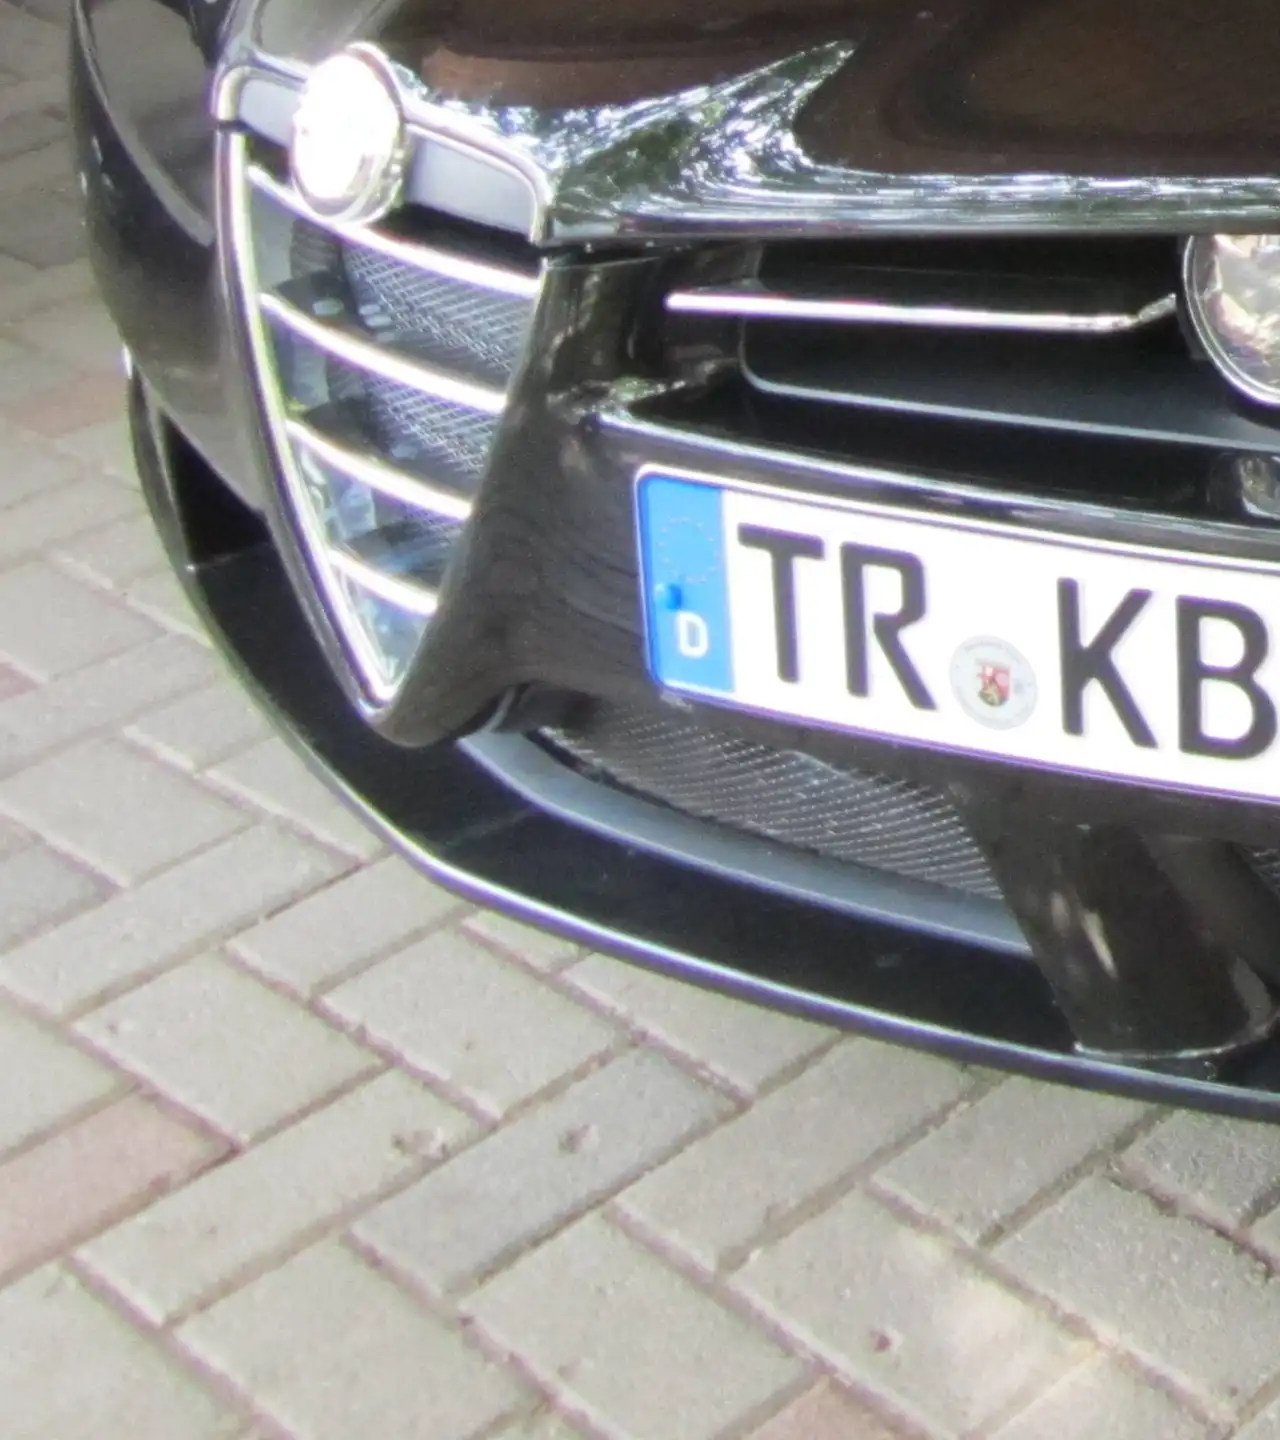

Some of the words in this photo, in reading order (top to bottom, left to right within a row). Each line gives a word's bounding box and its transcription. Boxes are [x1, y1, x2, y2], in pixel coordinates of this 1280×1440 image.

[676, 612, 708, 658] D
[738, 523, 939, 712] TR
[1056, 576, 1279, 760] KB
